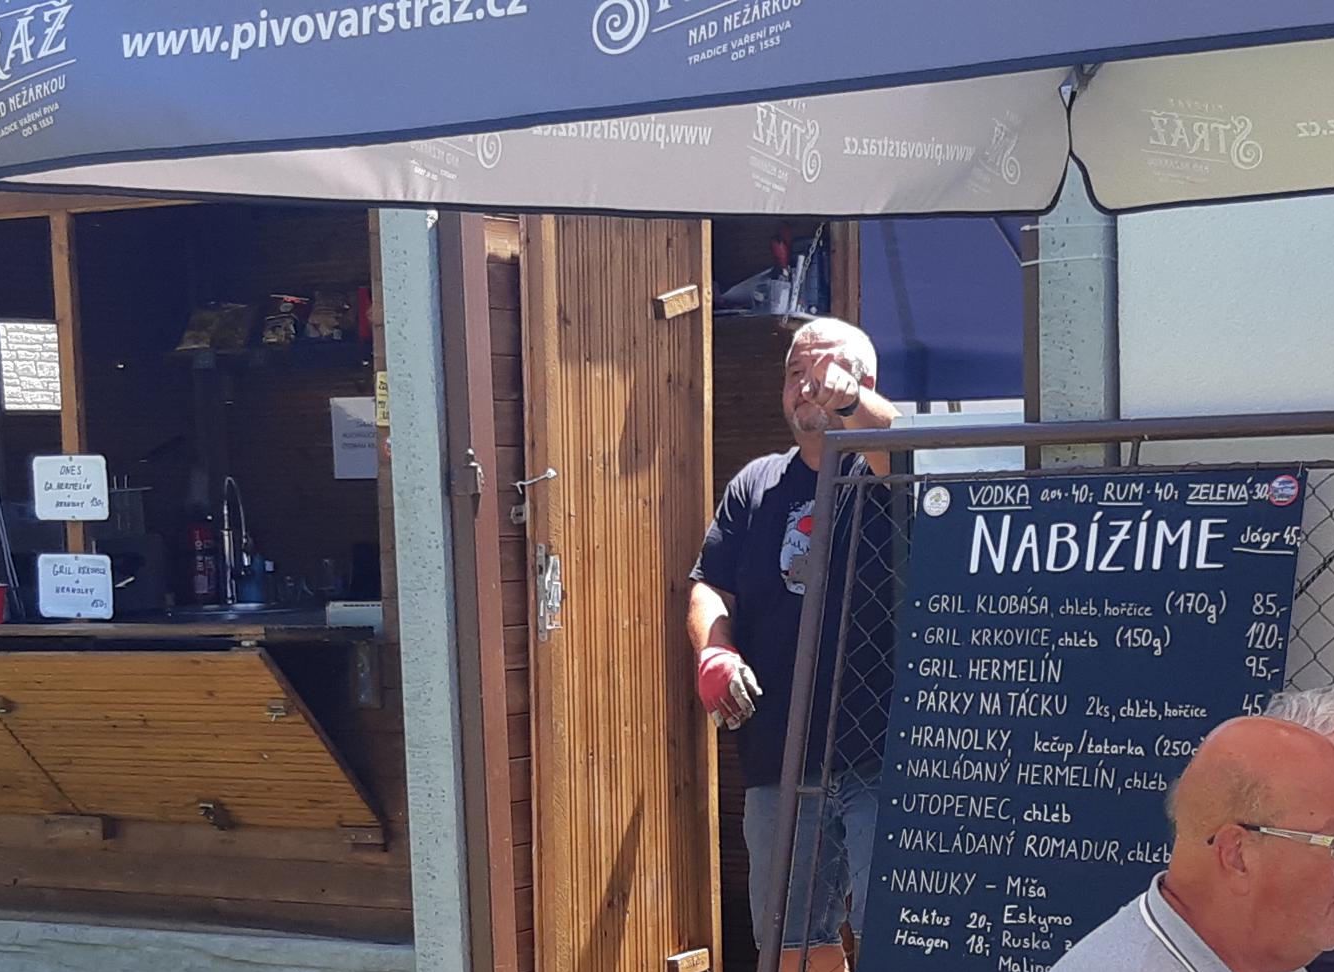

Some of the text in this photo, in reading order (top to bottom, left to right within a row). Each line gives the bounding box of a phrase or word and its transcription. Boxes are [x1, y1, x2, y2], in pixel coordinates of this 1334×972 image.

[121, 0, 530, 60] www.pivovarstraz.cz
[687, 21, 718, 47] NAD
[687, 19, 792, 66] TRADICE VAŘENÍ PIVA
[730, 49, 747, 63] OD
[747, 45, 758, 56] R.
[9, 74, 67, 112] NEŽÁRKOU
[60, 465, 82, 476] DNES
[969, 484, 1030, 505] VODKA
[1103, 482, 1144, 501] RUM
[1187, 477, 1249, 501] ZELENÁ
[969, 510, 1228, 574] NABÍZÍME
[1240, 526, 1280, 550] Jágr
[976, 586, 1055, 618] KLOBÁSA,
[1104, 598, 1153, 617] hořčice
[1165, 590, 1227, 624] (170g)
[1252, 593, 1288, 618] 85,-
[970, 628, 1055, 651] KRKOVICE,
[1058, 630, 1099, 648] chléb
[1115, 625, 1171, 656] (150g)
[919, 651, 1280, 683] GRIL. HERMELÍN 95,-
[916, 683, 975, 715] PÁRKY
[979, 692, 1001, 716] NA
[1007, 688, 1068, 717] TÁCKU
[1085, 697, 1116, 722] 2ks,
[1164, 699, 1208, 718] hořčice
[910, 725, 1012, 759] HRANOLKY,
[906, 753, 1167, 795] NAKLÁDANÝ HERMELÍN, chléb
[902, 793, 1072, 825] UTOPENEC, chléb
[899, 825, 1172, 866] NAKLÁDANÝ ROMADUR, chléb
[890, 868, 977, 896] NANUKY
[1006, 875, 1047, 898] Míša
[899, 907, 951, 927] Kaktus
[1003, 904, 1073, 934] Eskymo
[1001, 930, 1054, 951] Ruská
